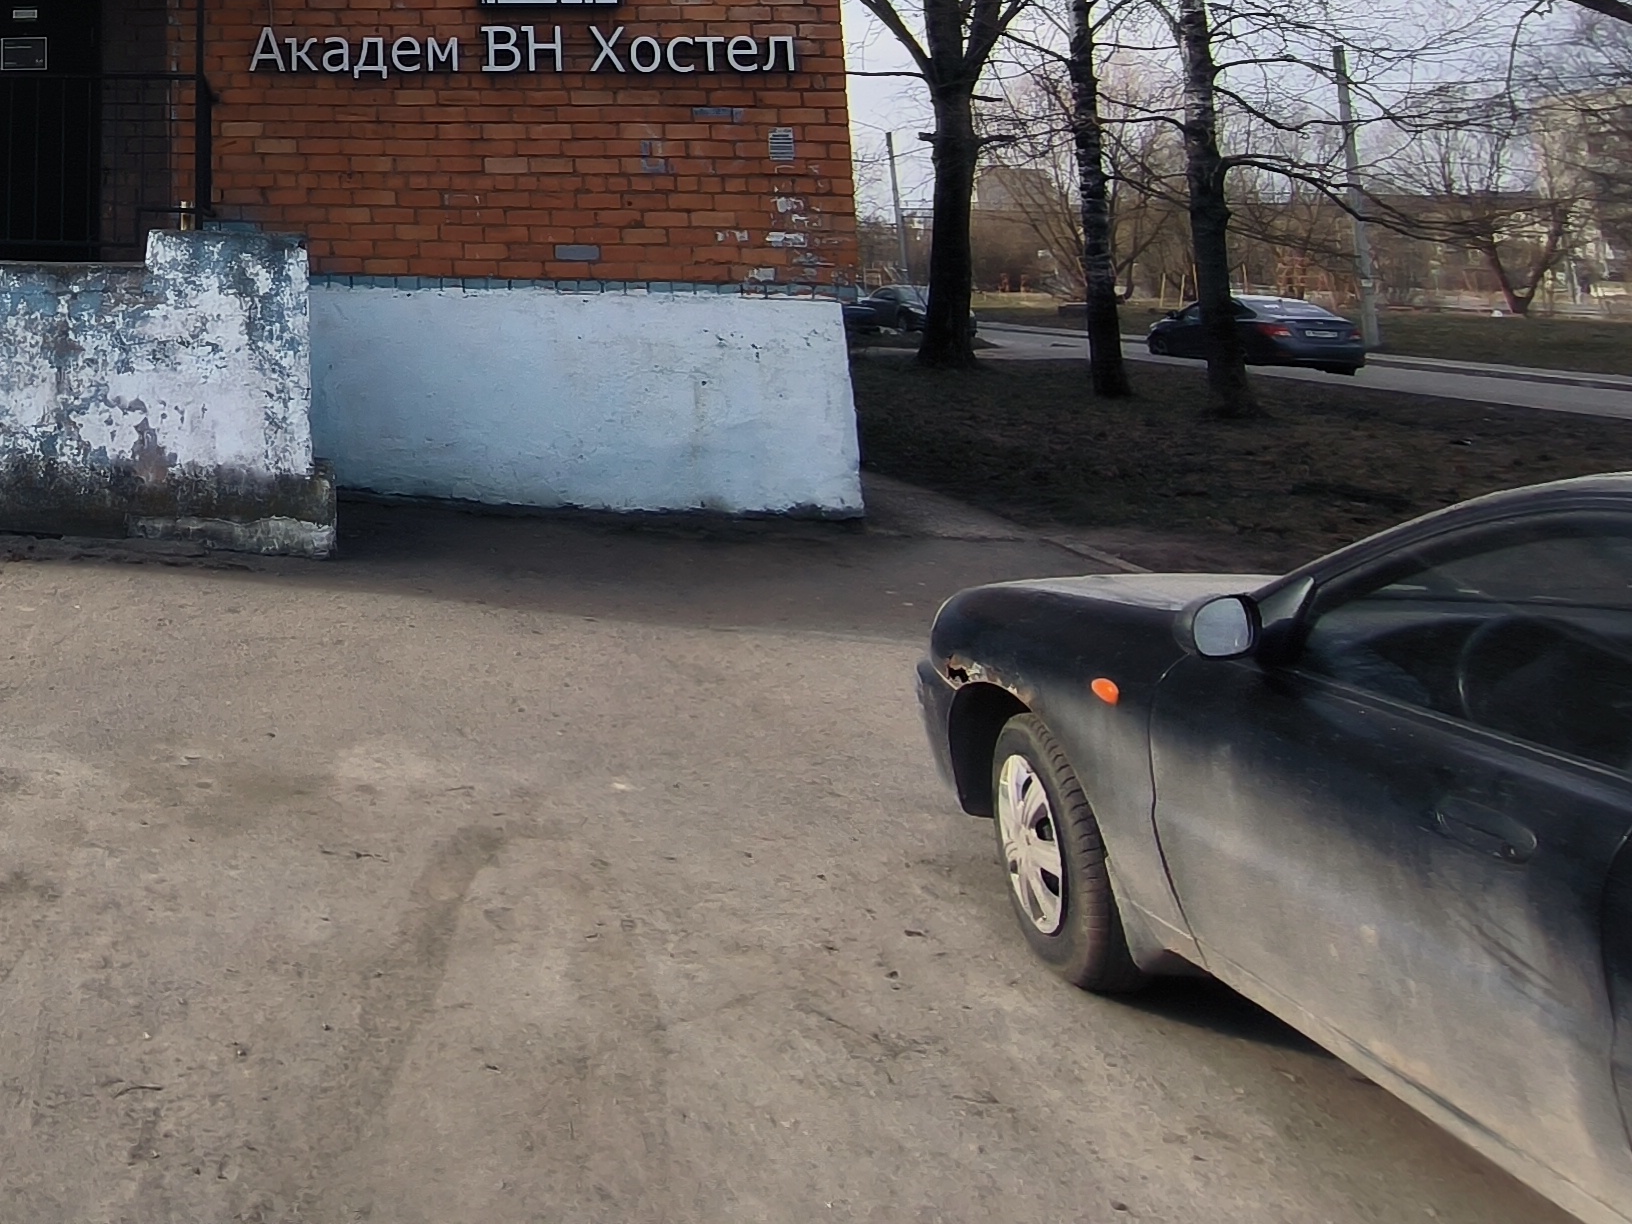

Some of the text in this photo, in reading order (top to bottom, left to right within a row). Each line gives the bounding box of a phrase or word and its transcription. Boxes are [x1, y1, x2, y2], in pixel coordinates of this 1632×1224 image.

[249, 25, 797, 79] Академ ВН Хостел
